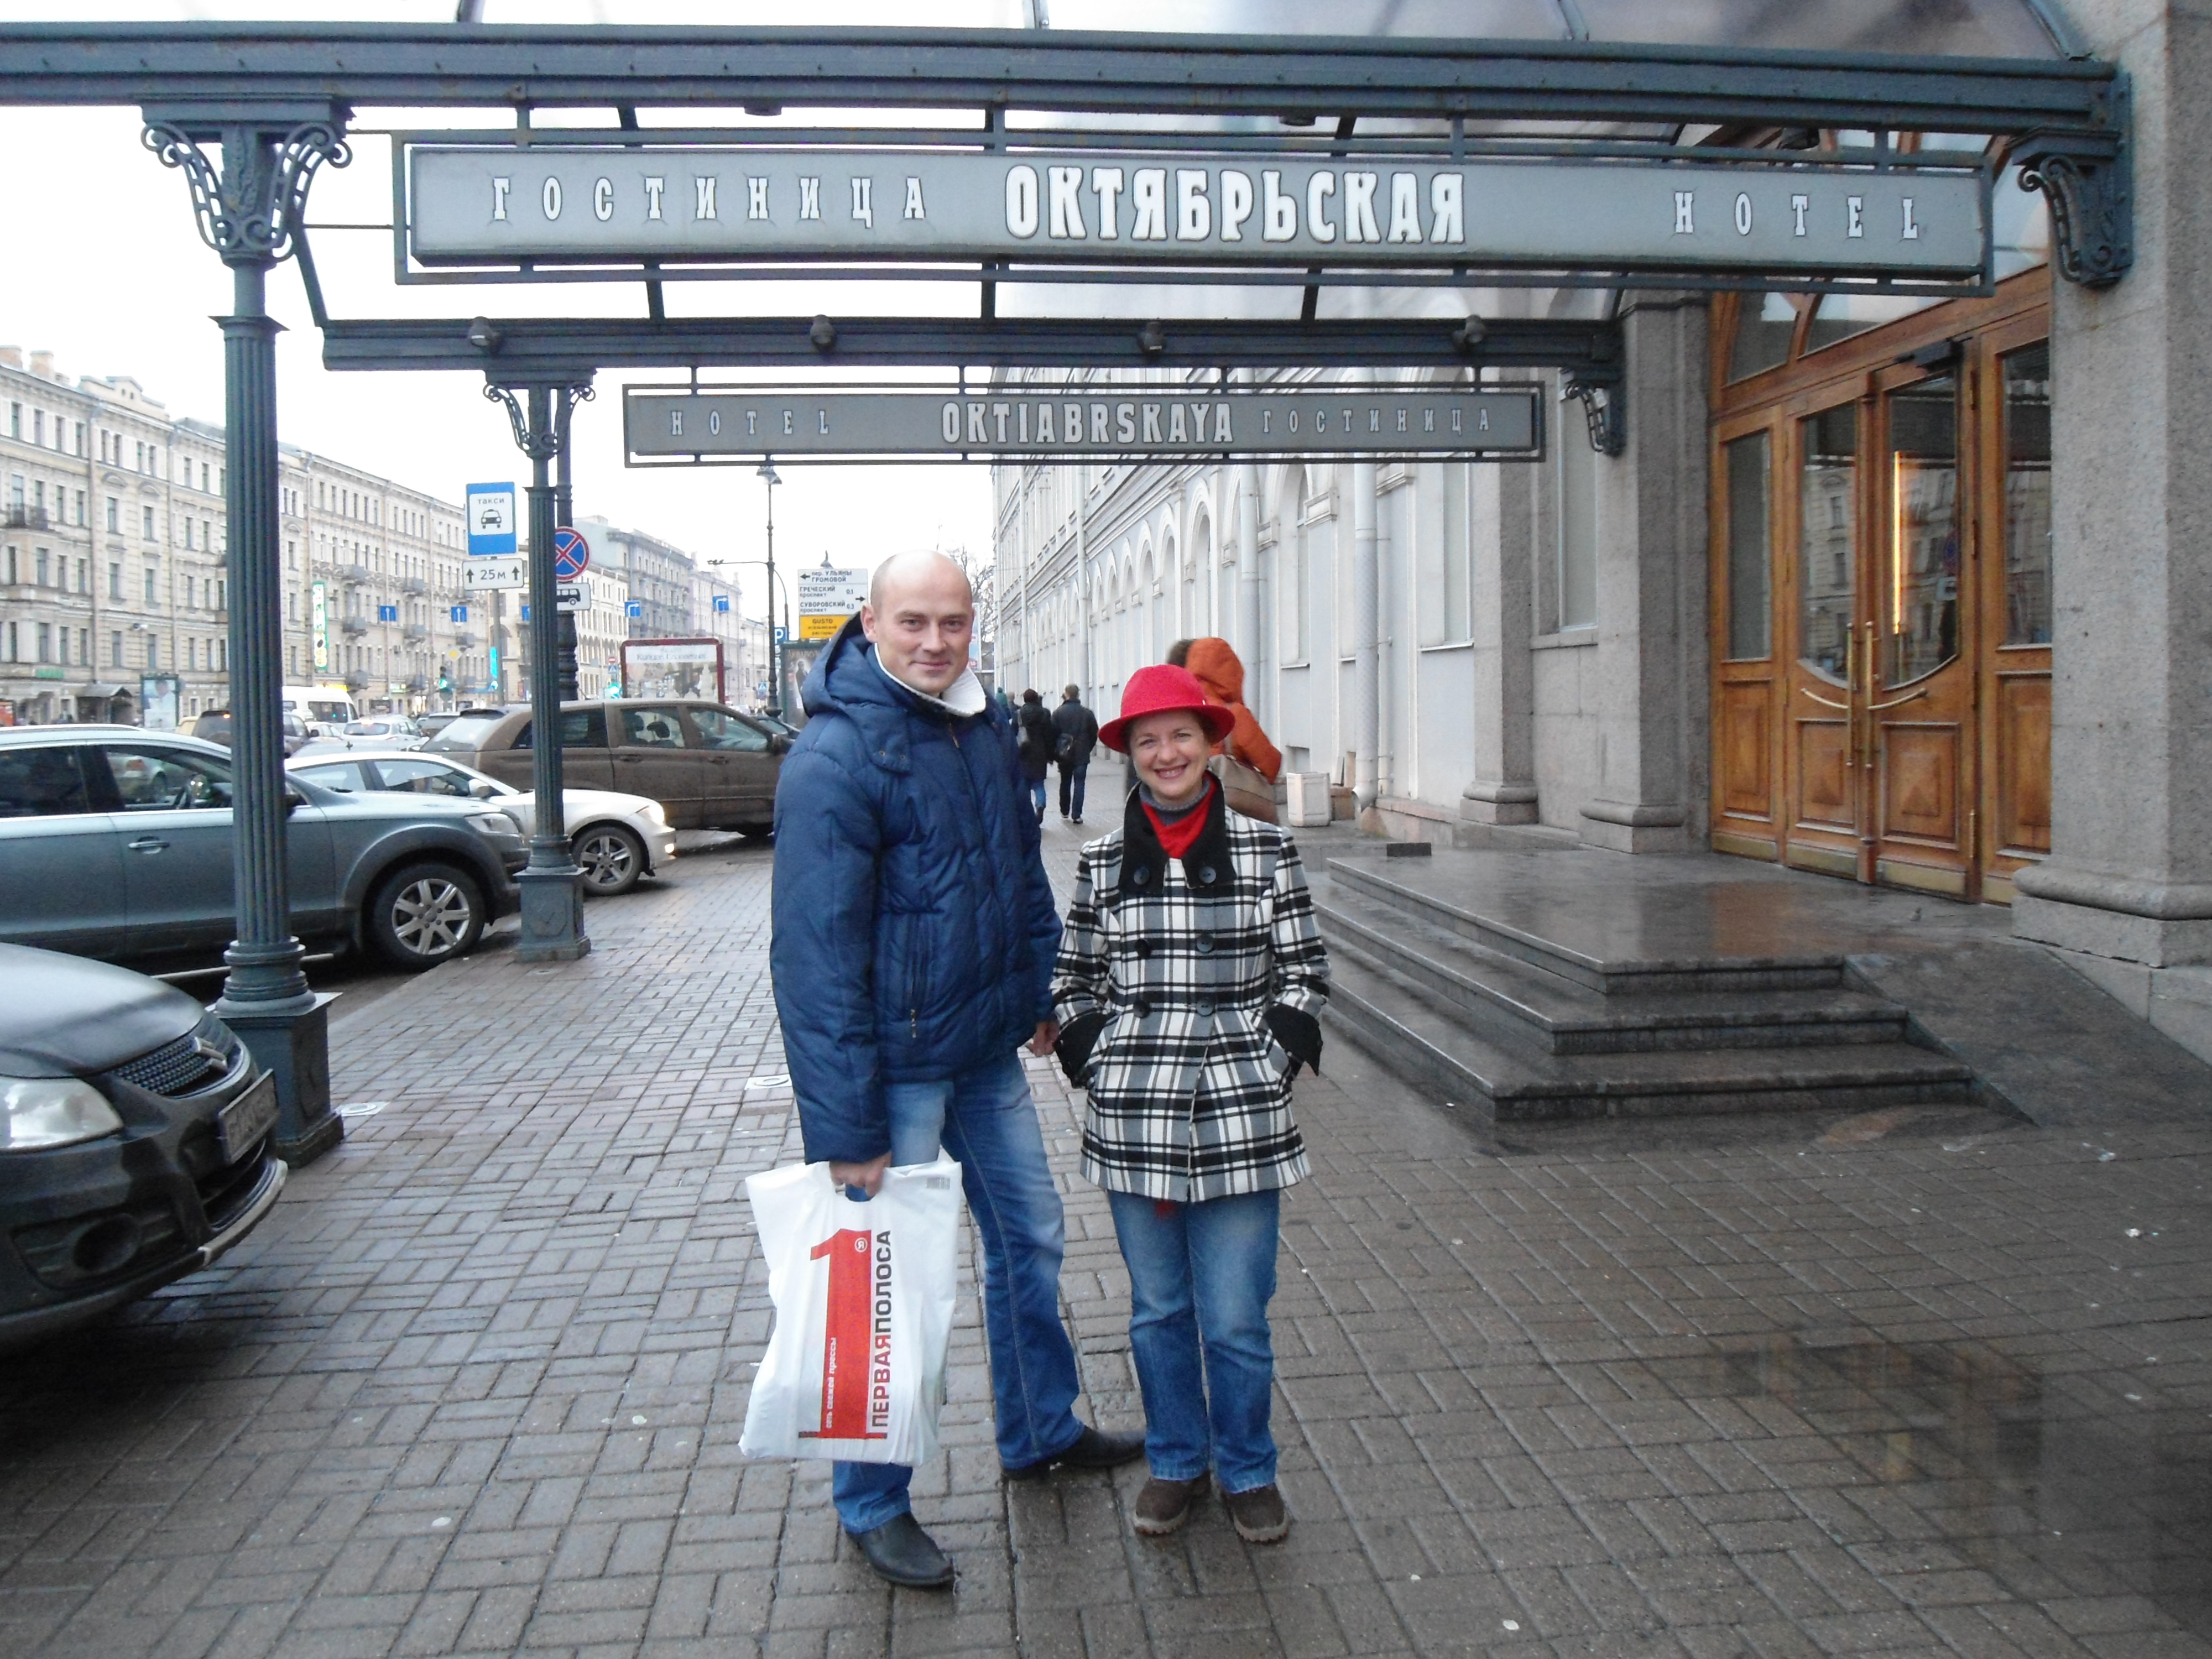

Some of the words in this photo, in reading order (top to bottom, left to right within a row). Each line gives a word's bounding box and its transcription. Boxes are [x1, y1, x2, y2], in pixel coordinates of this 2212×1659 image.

[492, 176, 926, 228] ГОСТИНИЦА
[1004, 164, 1465, 243] ОКТЯБРЬСКАЯ
[1674, 191, 1919, 239] HOTEL
[671, 410, 829, 436] HOTEL
[942, 402, 1233, 443] OKTIABRSKAYA
[1263, 409, 1489, 435] ГОСТИНИЦА
